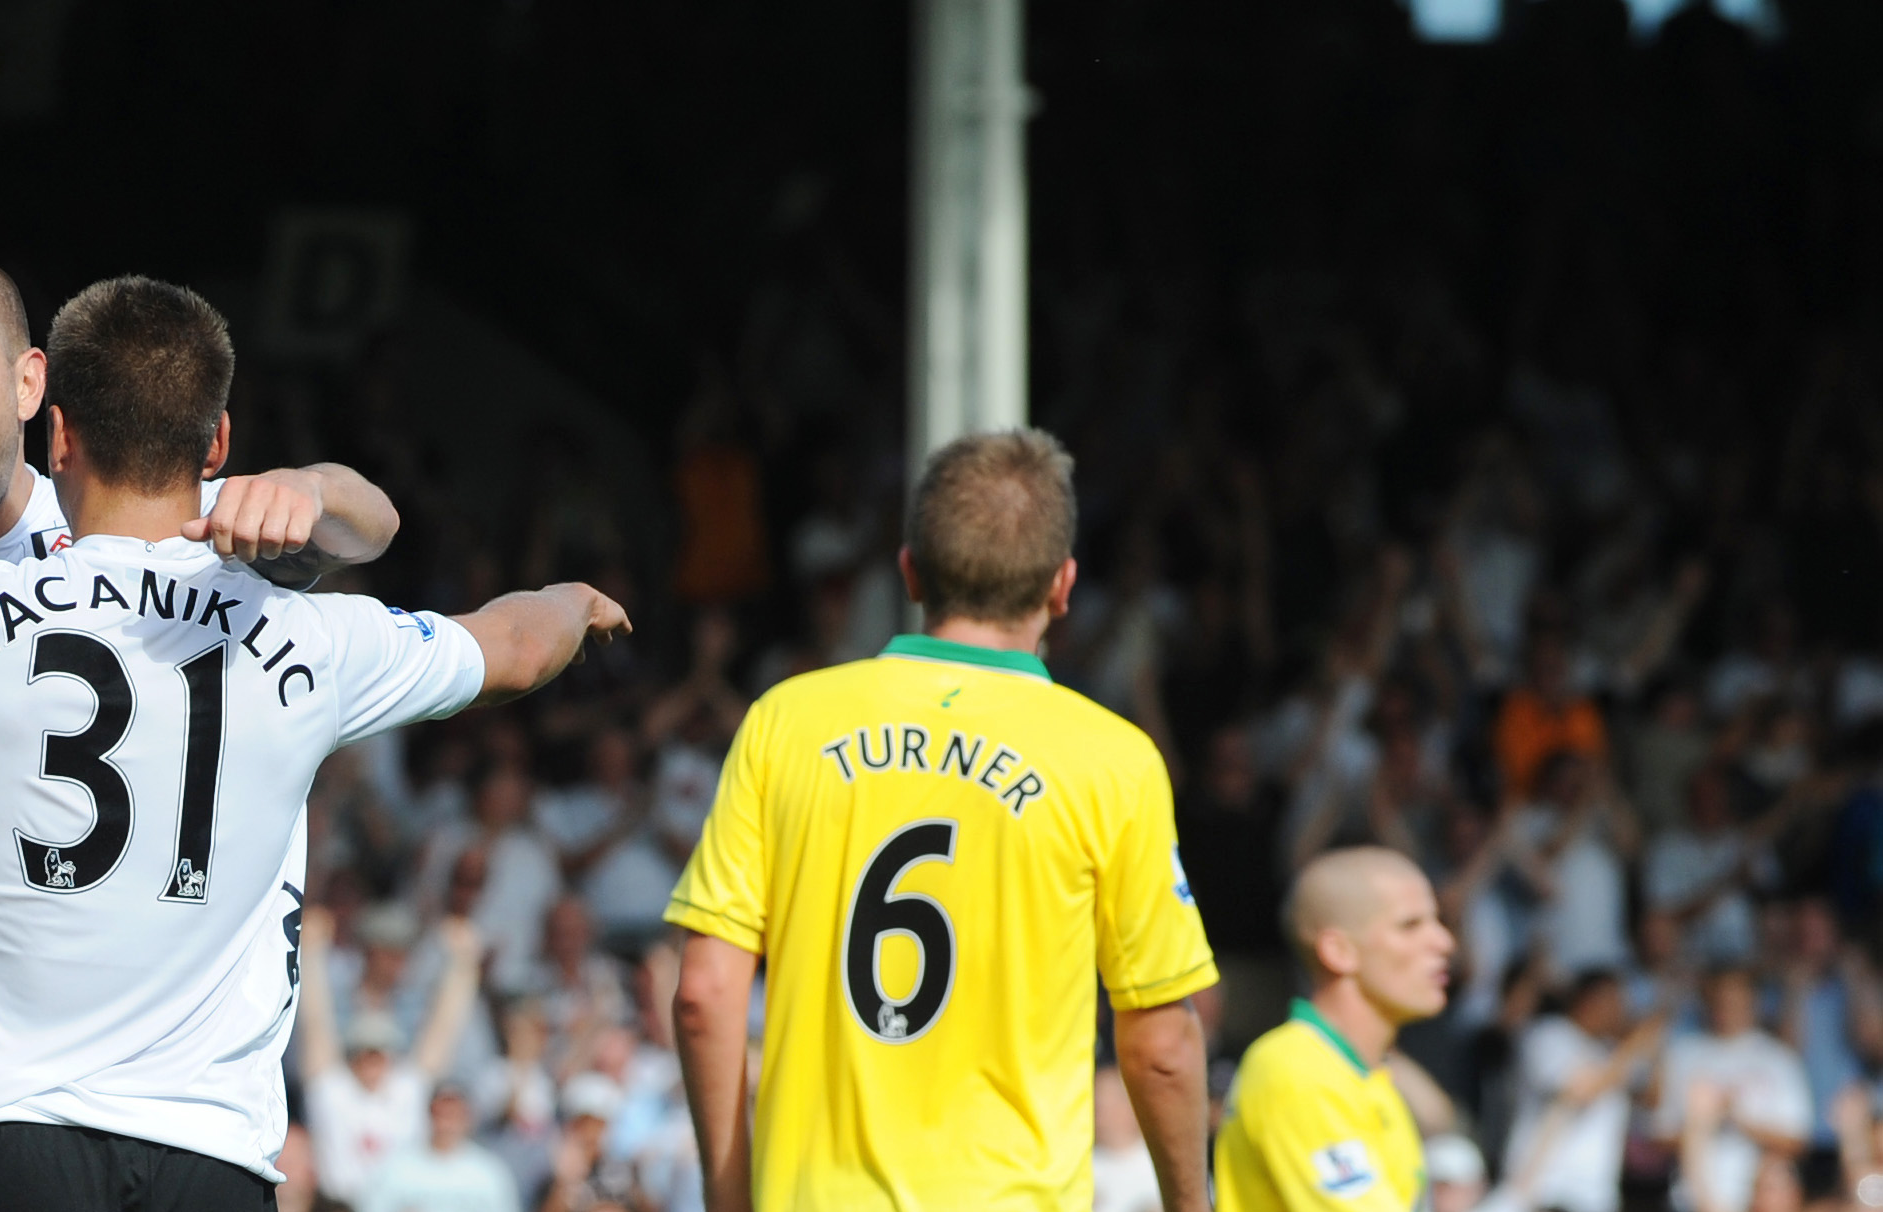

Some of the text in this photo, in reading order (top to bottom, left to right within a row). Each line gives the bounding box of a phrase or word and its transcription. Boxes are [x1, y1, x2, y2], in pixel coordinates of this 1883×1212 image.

[13, 628, 228, 904] 31
[823, 723, 1045, 817] TURNER
[841, 817, 959, 1045] 6
